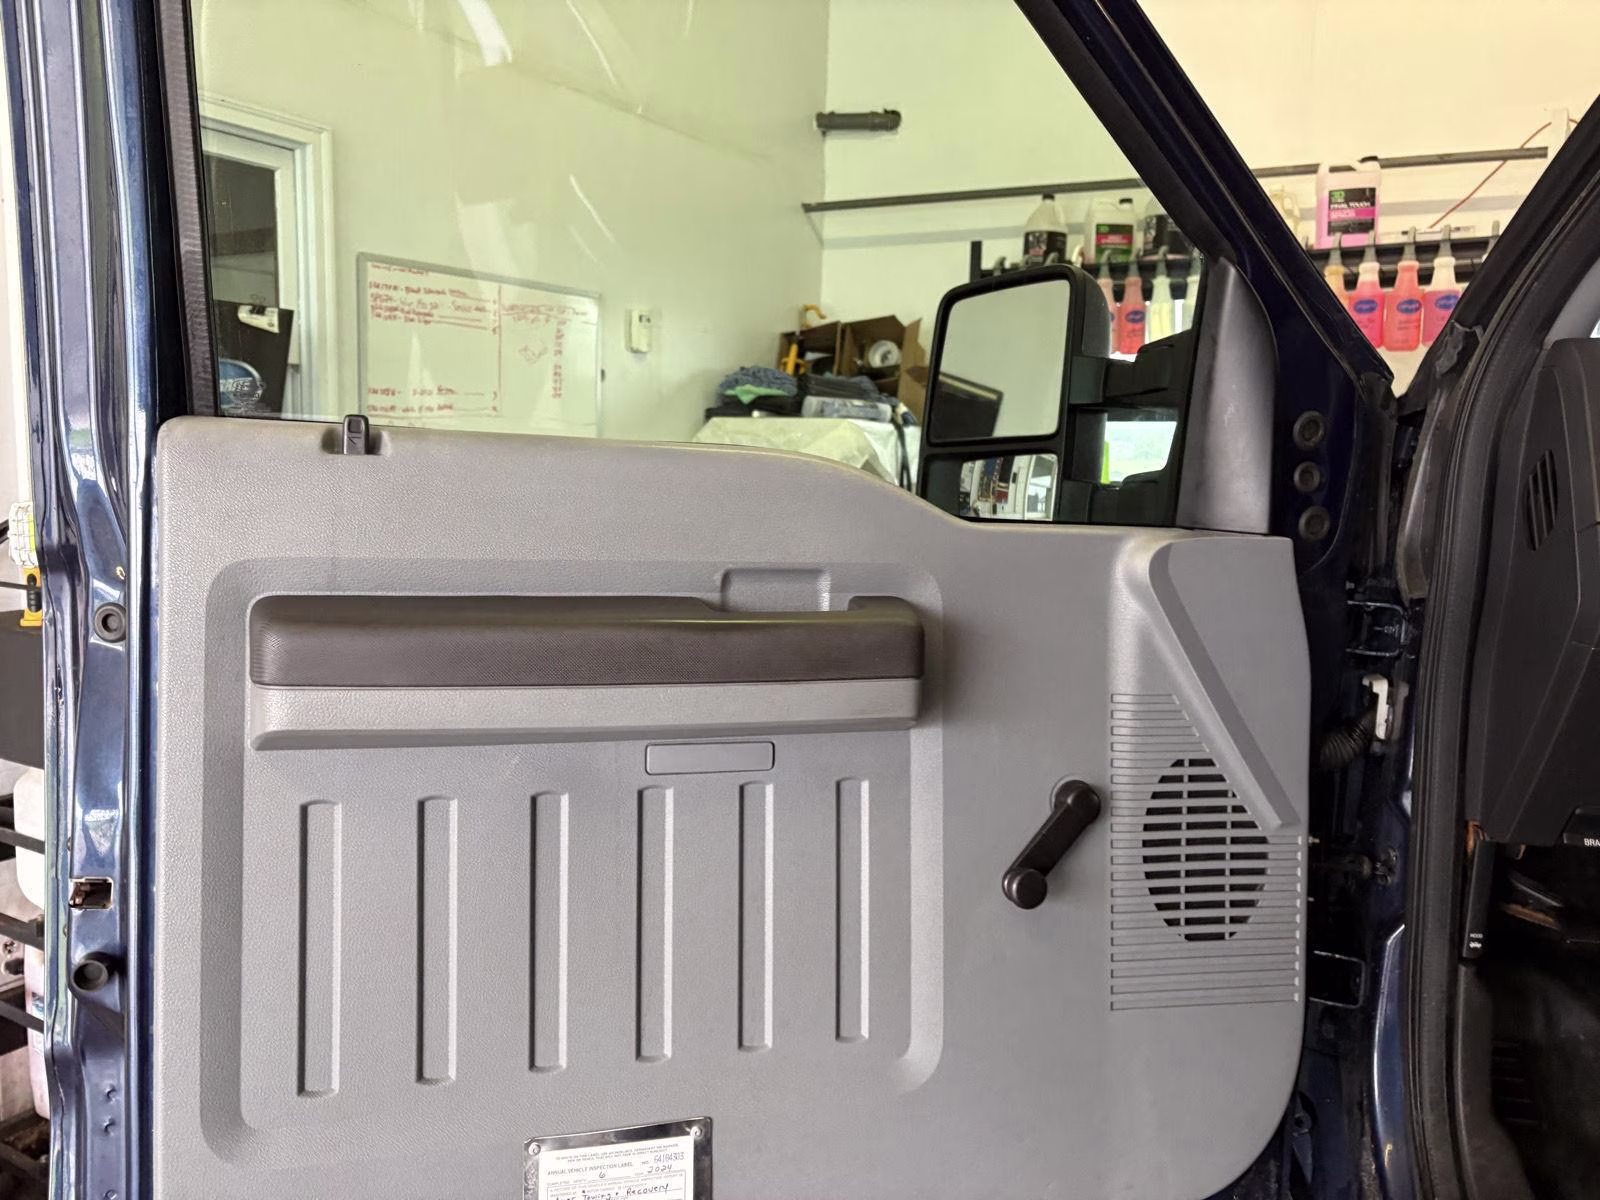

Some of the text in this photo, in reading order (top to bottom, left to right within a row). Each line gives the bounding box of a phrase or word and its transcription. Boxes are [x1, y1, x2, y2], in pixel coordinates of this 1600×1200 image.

[568, 1166, 588, 1174] VEHICLE
[589, 1163, 617, 1171] INSPECTION
[617, 1160, 633, 1169] LABEL
[647, 1164, 673, 1174] 2024
[626, 1183, 669, 1196] Recovery
